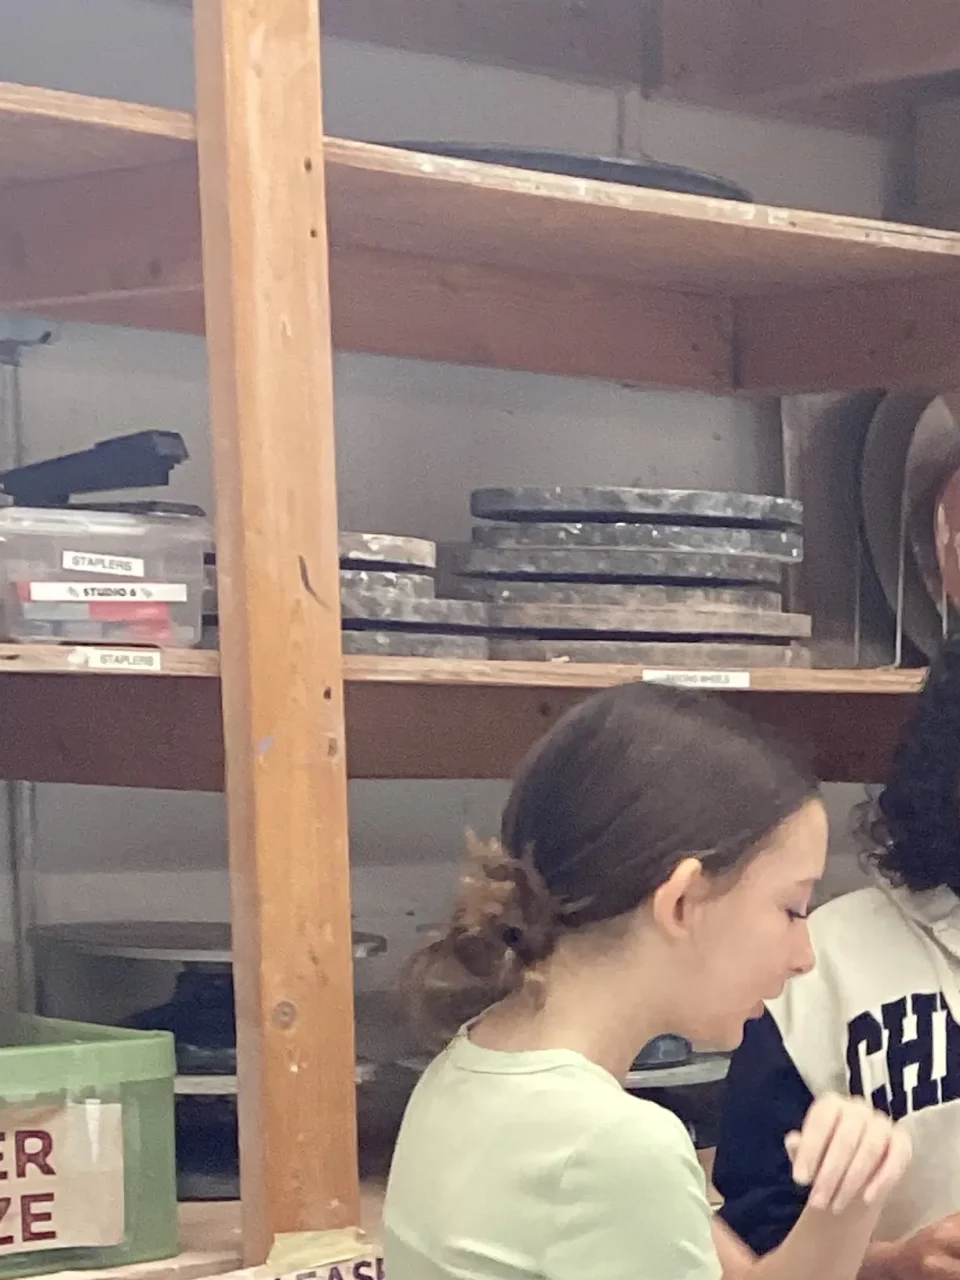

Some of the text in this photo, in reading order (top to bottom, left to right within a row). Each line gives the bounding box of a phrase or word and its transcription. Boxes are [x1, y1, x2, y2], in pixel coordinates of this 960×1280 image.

[71, 555, 132, 572] STAPLERS
[83, 587, 127, 597] STUDIO
[100, 653, 154, 667] STAPLERS
